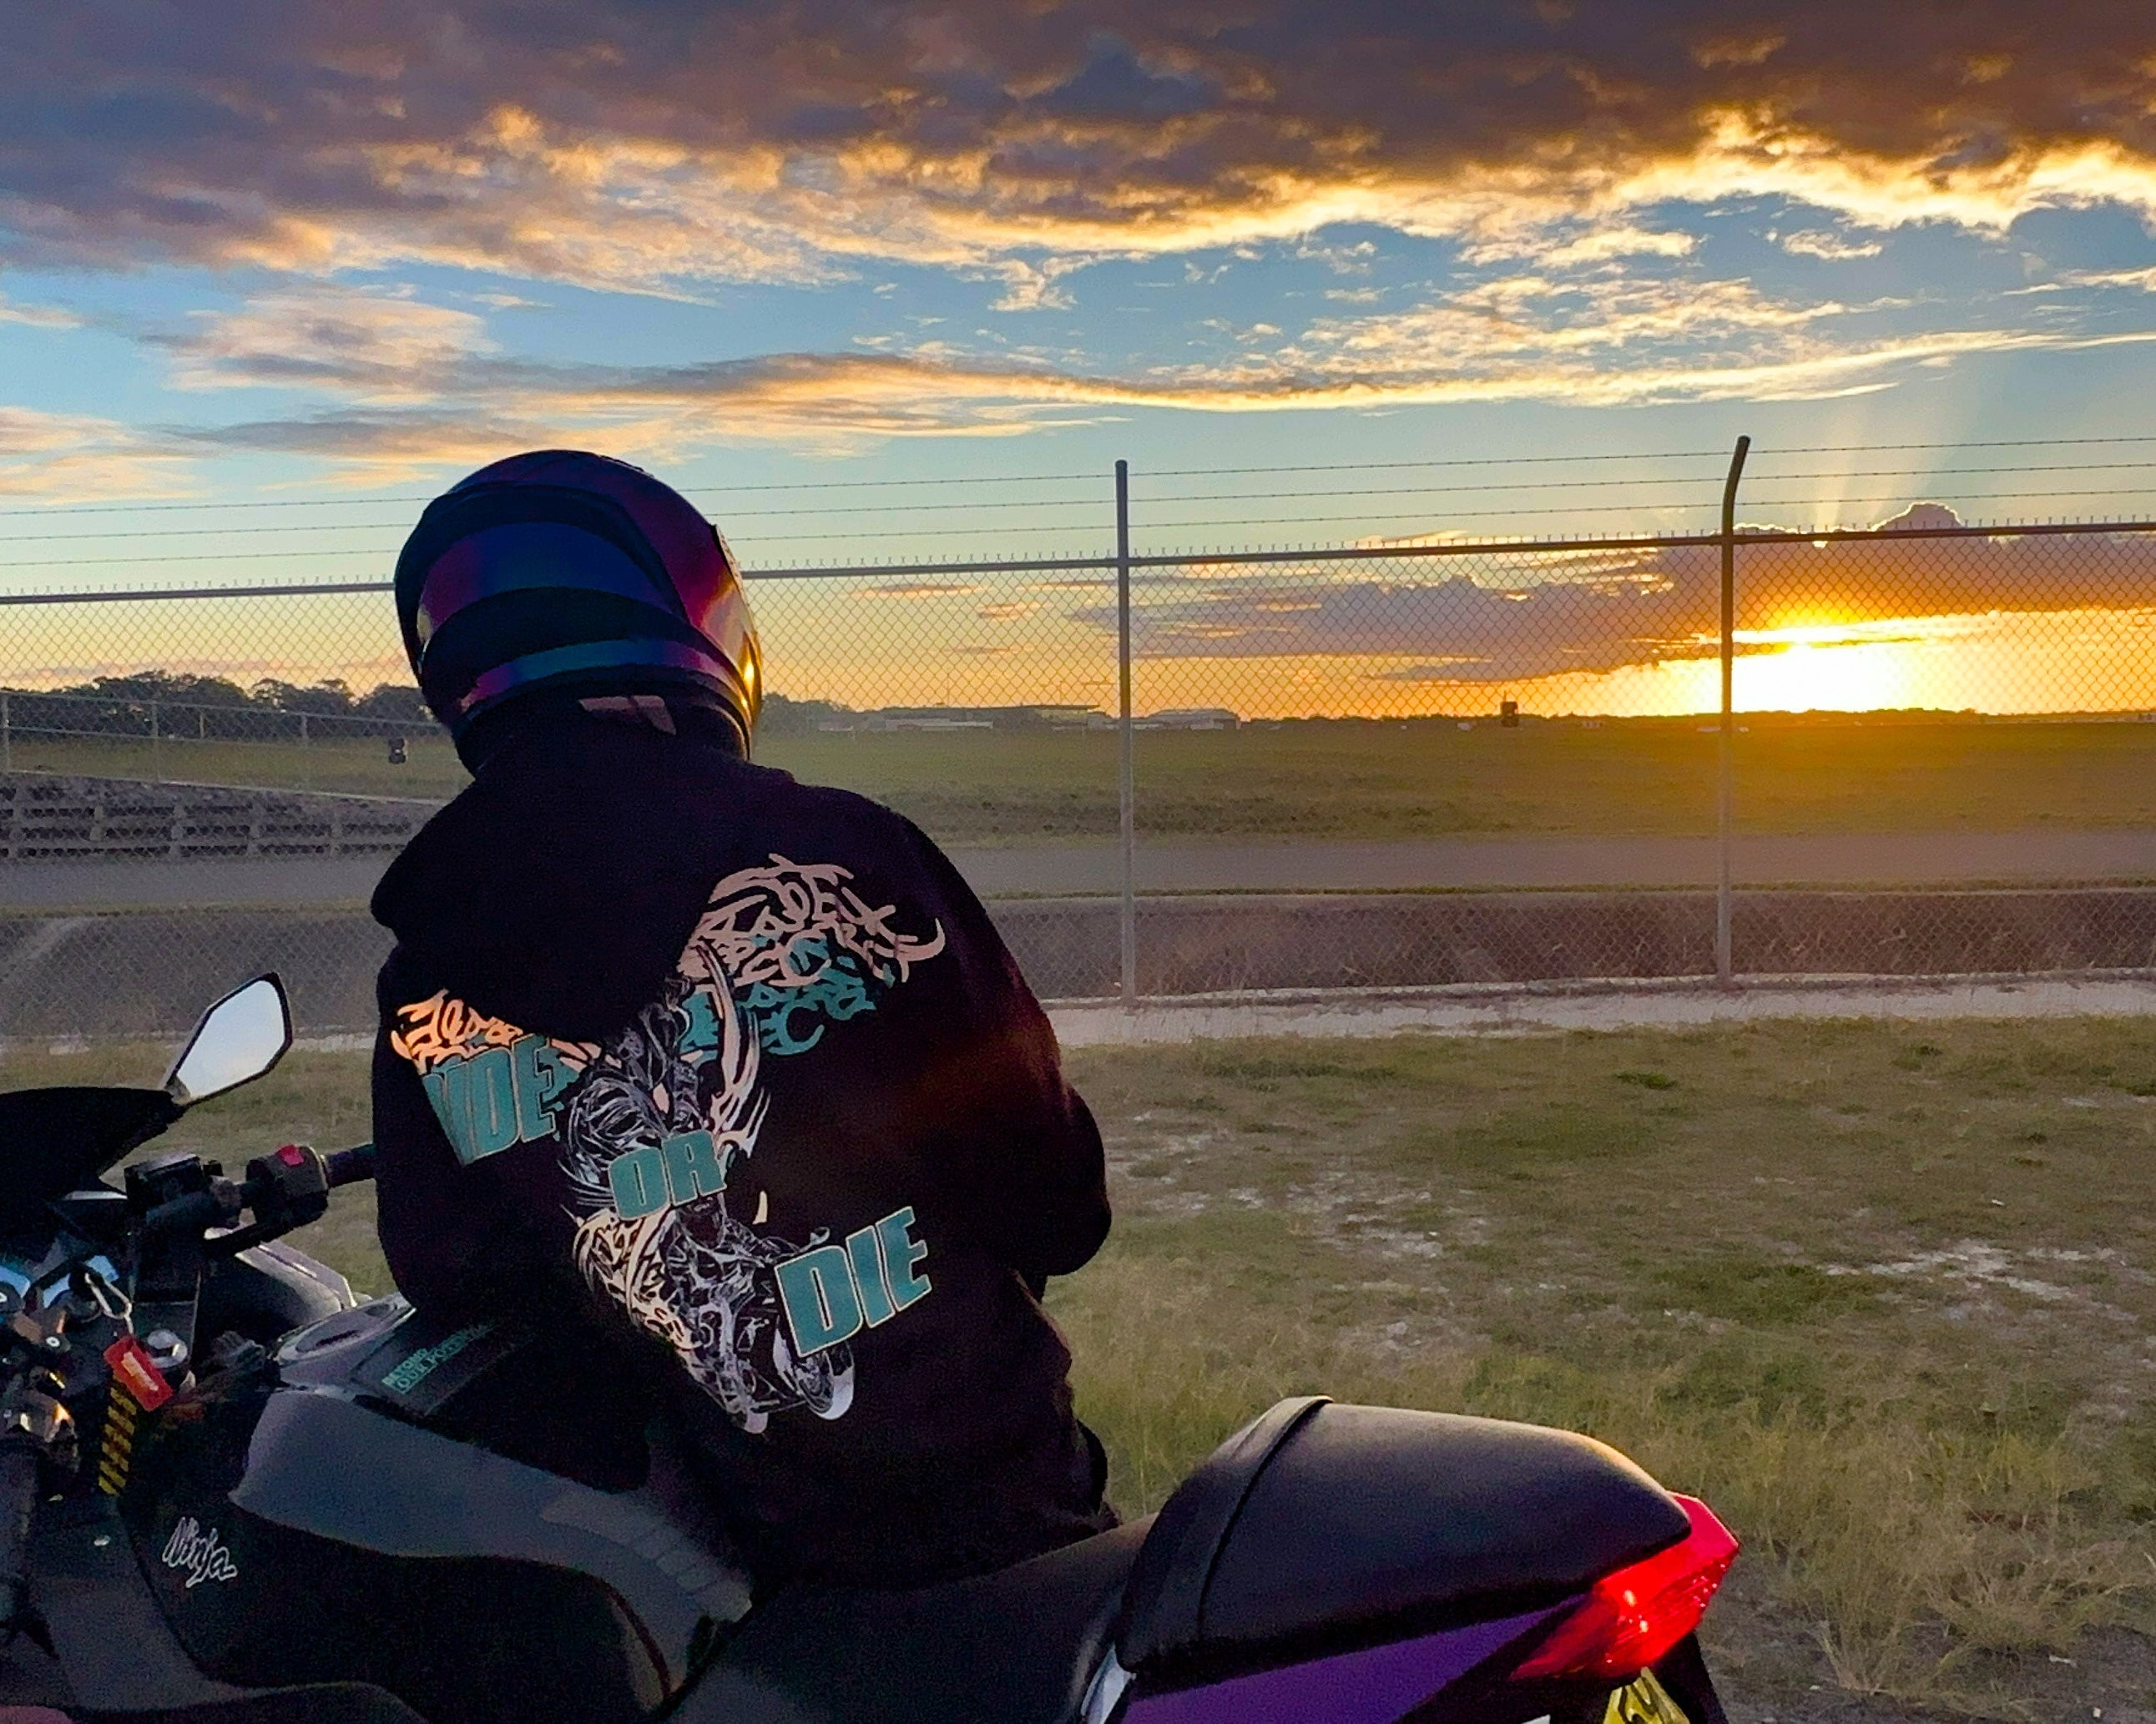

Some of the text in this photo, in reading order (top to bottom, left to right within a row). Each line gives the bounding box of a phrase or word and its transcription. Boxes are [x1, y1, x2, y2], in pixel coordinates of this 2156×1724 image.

[608, 1128, 728, 1221] OR
[774, 1206, 932, 1358] DIE
[161, 1516, 239, 1589] Ninja
